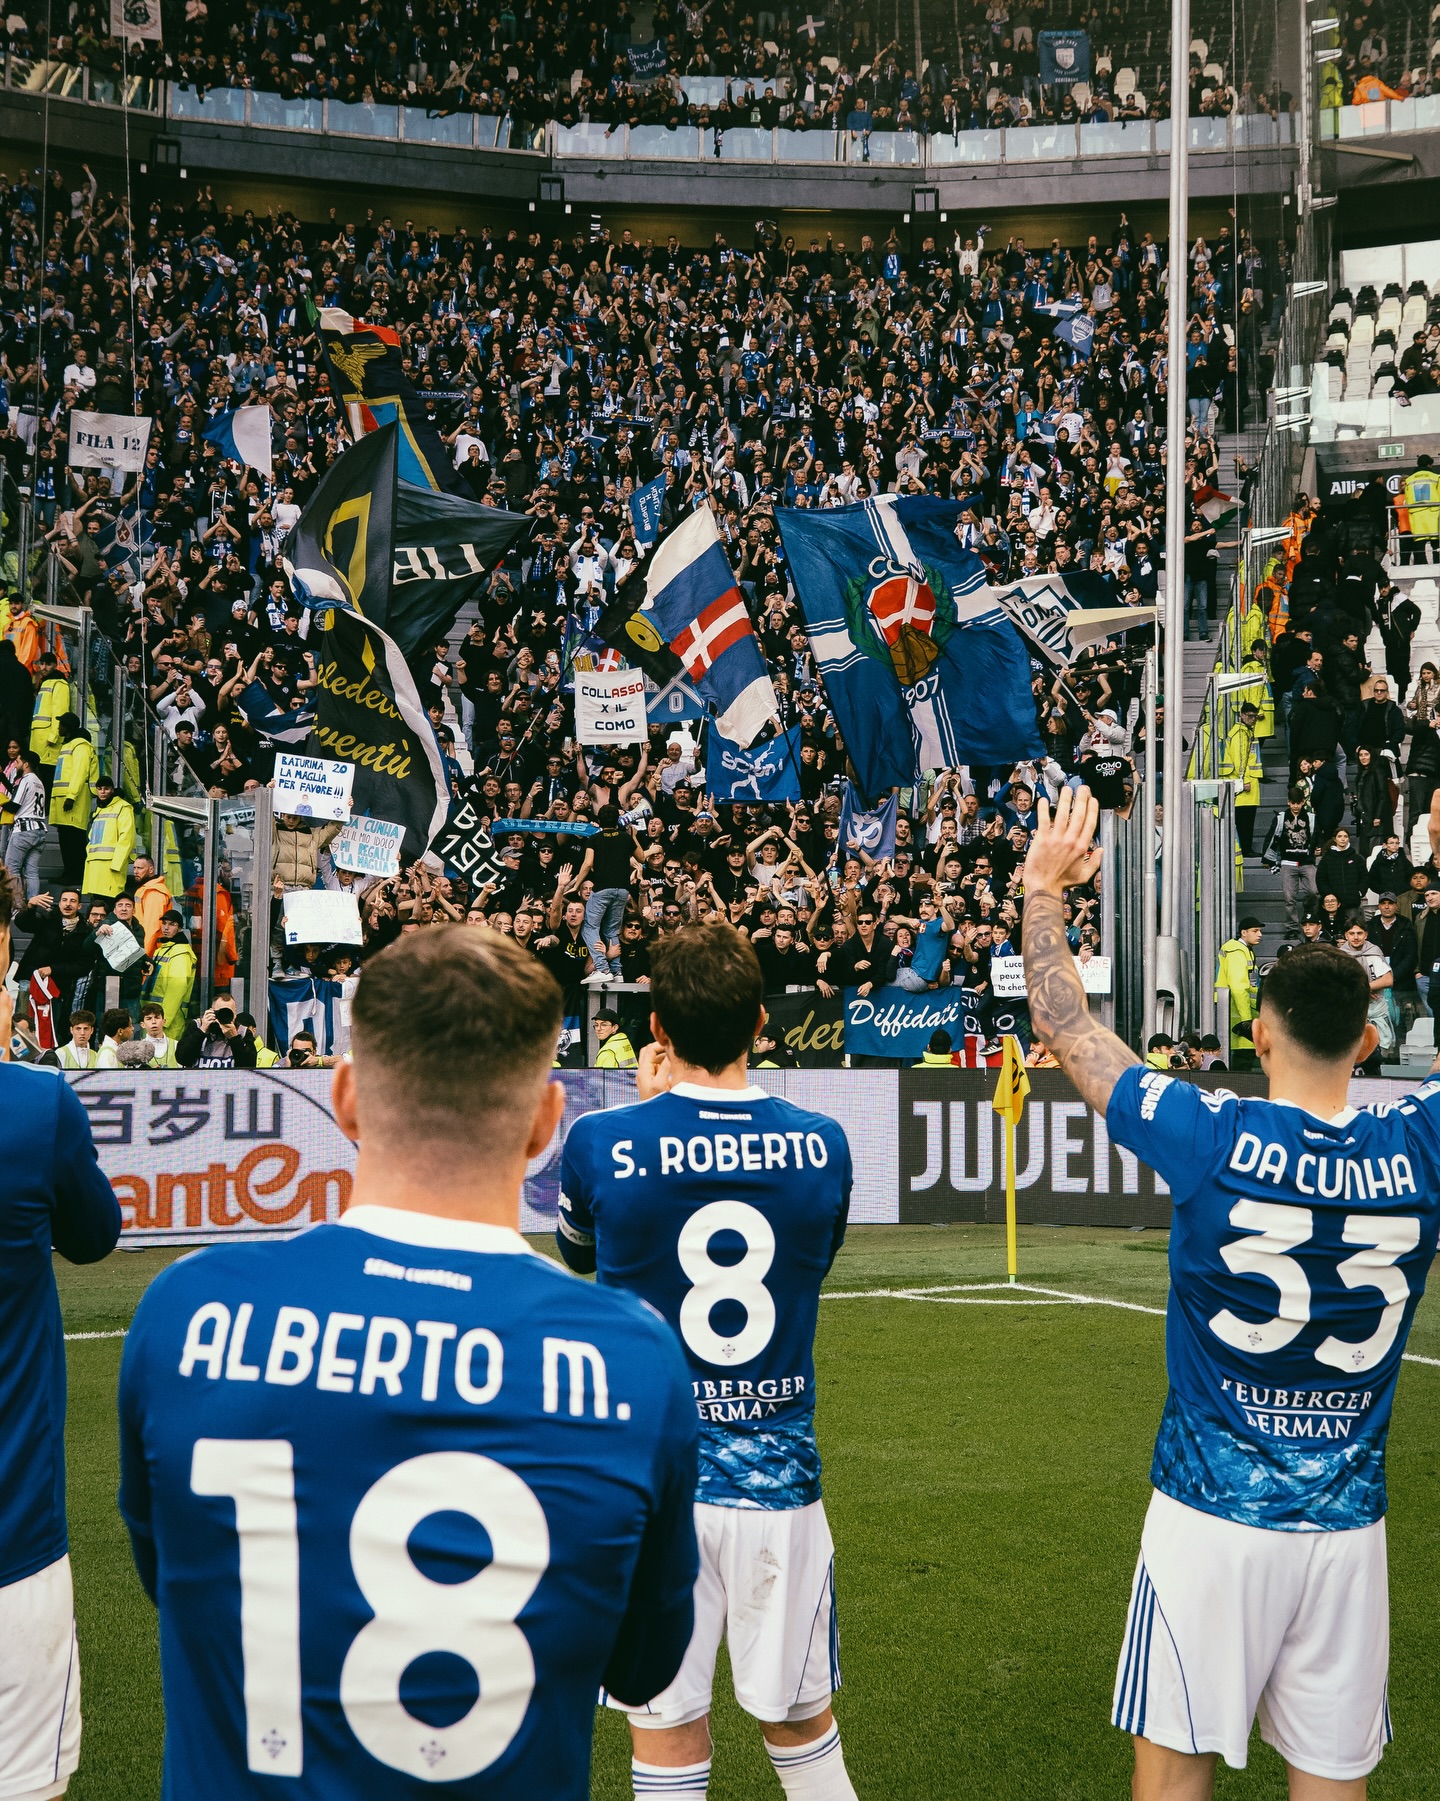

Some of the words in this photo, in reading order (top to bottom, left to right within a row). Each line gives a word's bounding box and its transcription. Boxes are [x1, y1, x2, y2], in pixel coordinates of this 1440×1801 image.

[76, 430, 114, 450] FILA
[122, 436, 141, 451] 12
[1330, 480, 1369, 495] Allia
[582, 682, 644, 698] COLLASSO
[600, 704, 609, 713] X
[615, 704, 627, 712] IL
[595, 719, 635, 730] COMO
[280, 768, 292, 778] LA
[282, 756, 324, 770] BATURINA
[332, 764, 347, 774] 20
[1096, 762, 1122, 771] COMO
[279, 779, 295, 790] PER
[364, 820, 399, 839] CUNHA
[502, 820, 588, 831] ULTRAS
[340, 840, 351, 852] MI
[358, 843, 390, 862] REGALI
[360, 833, 370, 844] MIO
[374, 836, 394, 850] IDOLO
[341, 854, 353, 866] LA
[848, 999, 959, 1037] Diffidati
[77, 1087, 282, 1145] 百岁山
[612, 1140, 647, 1179] S.
[659, 1132, 828, 1175] ROBERTO
[910, 1101, 1170, 1195] JUVEN
[1229, 1132, 1288, 1185] DA
[1295, 1153, 1417, 1200] CUNHA
[678, 1200, 776, 1366] 8
[1208, 1198, 1421, 1373] 33
[178, 1301, 504, 1405] ALBERTO
[542, 1336, 631, 1421] M.
[190, 1437, 550, 1783] 18
